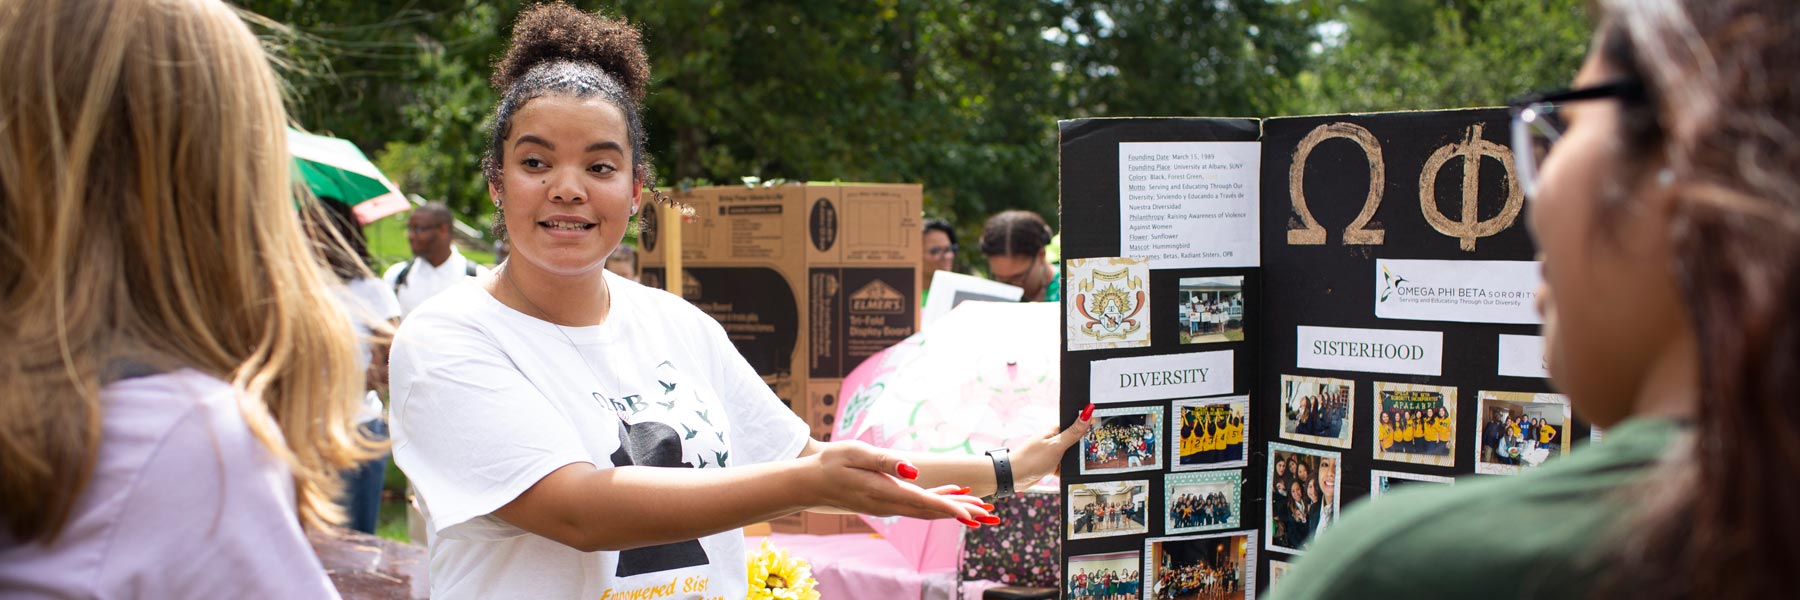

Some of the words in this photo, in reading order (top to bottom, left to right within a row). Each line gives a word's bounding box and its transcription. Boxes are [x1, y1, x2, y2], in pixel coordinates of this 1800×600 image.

[1397, 286, 1435, 297] OMEGA
[1438, 288, 1455, 297] PHI
[1458, 288, 1486, 298] BETA
[1488, 291, 1538, 299] SORORITY
[1313, 339, 1424, 361] SISTERHOOD
[1120, 368, 1209, 388] DIVERSITY
